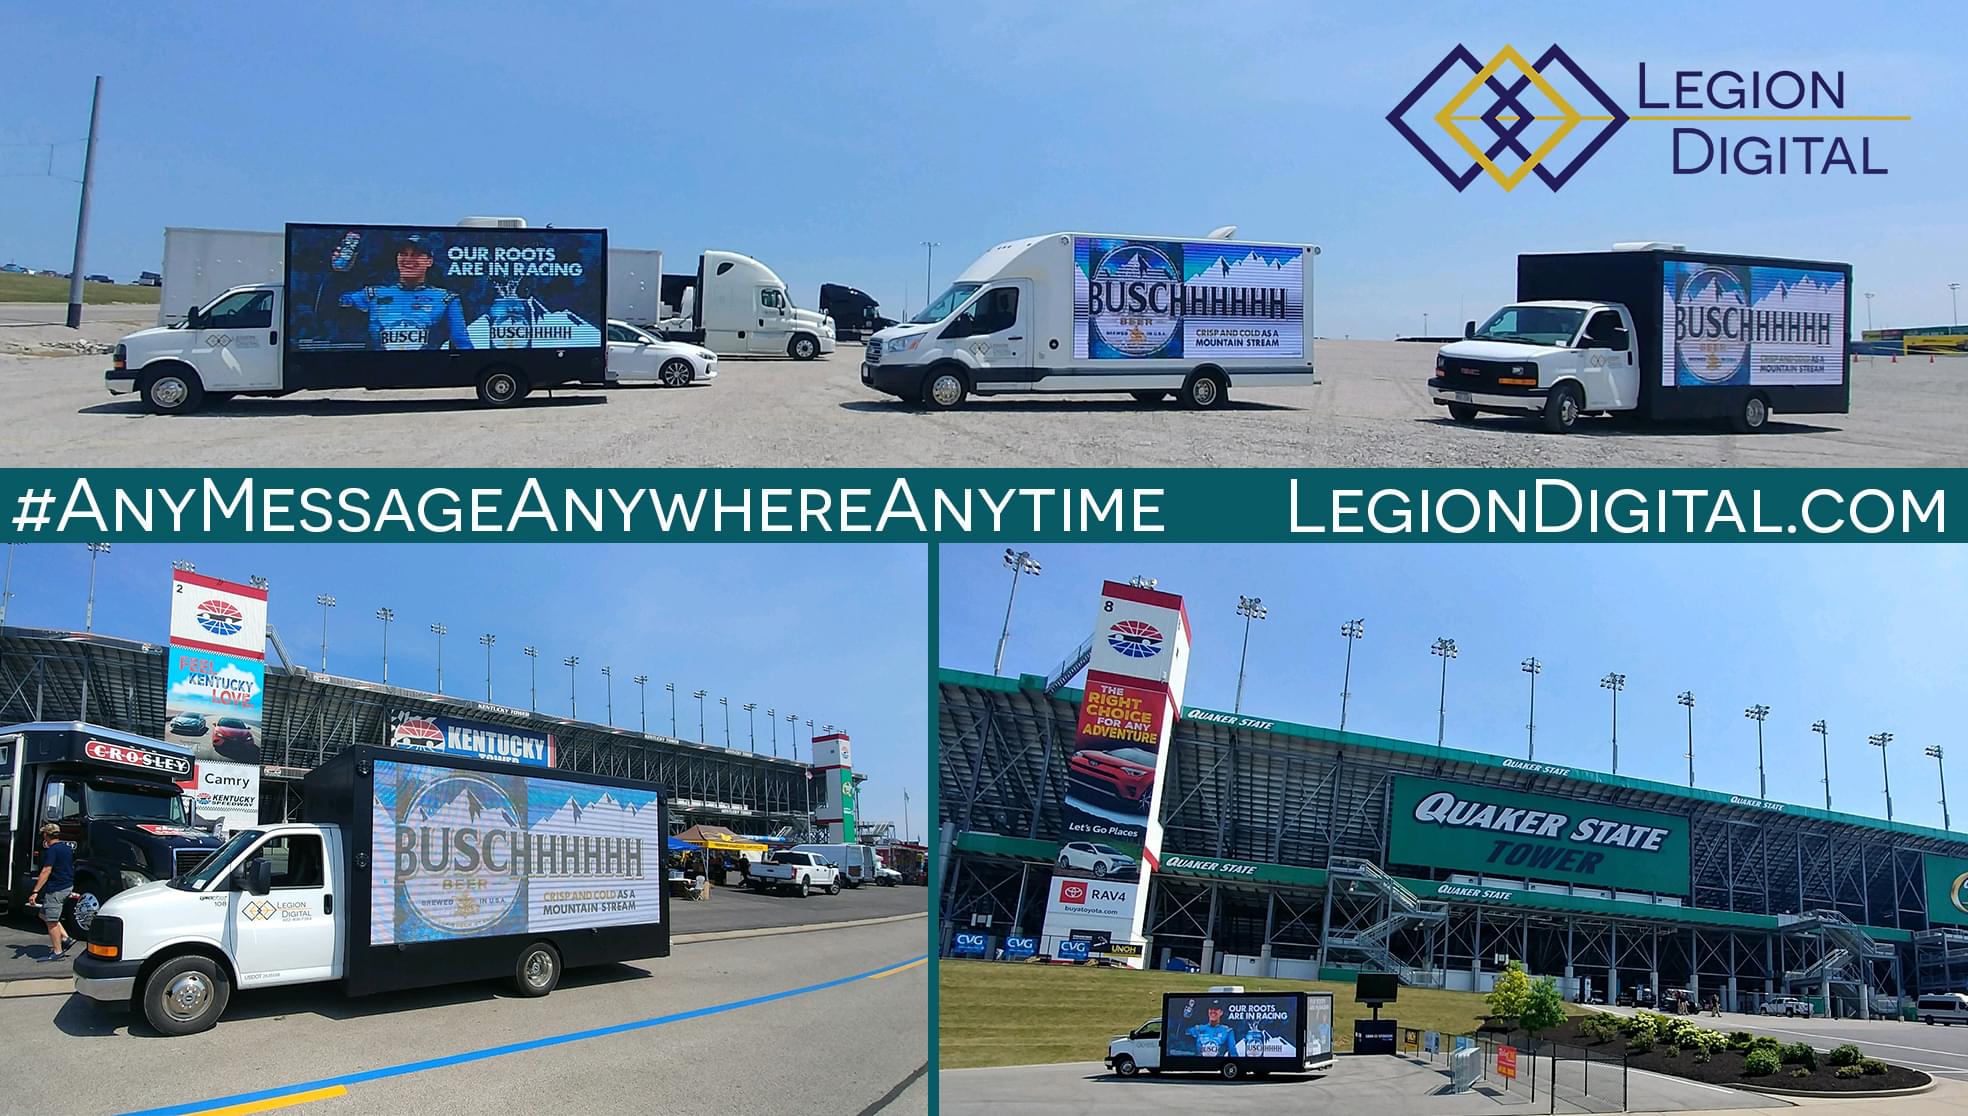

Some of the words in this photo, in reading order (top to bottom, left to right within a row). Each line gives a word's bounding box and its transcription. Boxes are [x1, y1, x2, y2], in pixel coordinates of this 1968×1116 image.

[447, 247, 489, 262] OUR
[494, 247, 556, 262] ROOTS
[447, 262, 483, 276] ARE
[488, 262, 509, 276] IN
[515, 262, 583, 277] RACING
[380, 330, 428, 345] BUSCH
[1219, 329, 1239, 337] AND
[1240, 329, 1260, 337] COLD
[1261, 329, 1272, 337] AS
[1273, 329, 1279, 337] A
[1195, 338, 1244, 347] MOUNTAIN
[1246, 338, 1280, 347] STREAM
[176, 584, 183, 593] 2
[1103, 600, 1114, 613] 8
[180, 656, 216, 675] FEEL
[188, 673, 254, 693] KENTUCKY
[1100, 685, 1125, 695] THE
[1088, 692, 1143, 711] RIGHT
[1086, 704, 1152, 724] CHOICE
[1188, 708, 1238, 725] QUAKER
[1239, 718, 1275, 730] STATE
[1096, 716, 1121, 728] FOR
[1124, 721, 1151, 732] ANY
[1082, 723, 1157, 744] ADVENTURE
[447, 725, 545, 761] KENTUCKY
[1502, 758, 1543, 773] QUAKER
[1542, 766, 1571, 776] STATE
[204, 772, 250, 790] Camry
[212, 794, 256, 804] KENTUCKY
[1730, 795, 1762, 808] QUAKER
[1763, 802, 1785, 811] STATE
[1415, 792, 1567, 838] QUAKER
[1570, 818, 1669, 851] STATE
[1068, 822, 1091, 833] Let's
[1092, 825, 1108, 835] Go
[1108, 826, 1139, 838] Places
[1486, 839, 1605, 875] TOWER
[1166, 856, 1219, 871] QUAKER
[1219, 863, 1258, 875] STATE
[441, 878, 488, 890] BEER
[543, 890, 570, 902] CRISP
[570, 890, 592, 901] AND
[593, 890, 616, 901] COLD
[617, 889, 629, 900] AS
[629, 889, 636, 899] A
[1091, 889, 1126, 902] RAV4
[1437, 884, 1480, 897] QUAKER
[1481, 889, 1513, 900] STATE
[421, 898, 454, 906] BREWED
[542, 903, 598, 916] MOUNTAIN
[601, 900, 636, 913] STREAM
[1064, 905, 1118, 915] buyatoyota.com
[956, 934, 984, 945] CVG
[1007, 938, 1034, 949] CVG
[1060, 941, 1087, 952] CVG
[1111, 944, 1137, 954] UNOH
[1227, 1012, 1245, 1020] ARE
[1245, 1012, 1255, 1020] IN
[1255, 1011, 1288, 1020] RACING
[1228, 1004, 1247, 1012] OUR
[1248, 1004, 1276, 1012] ROOTS
